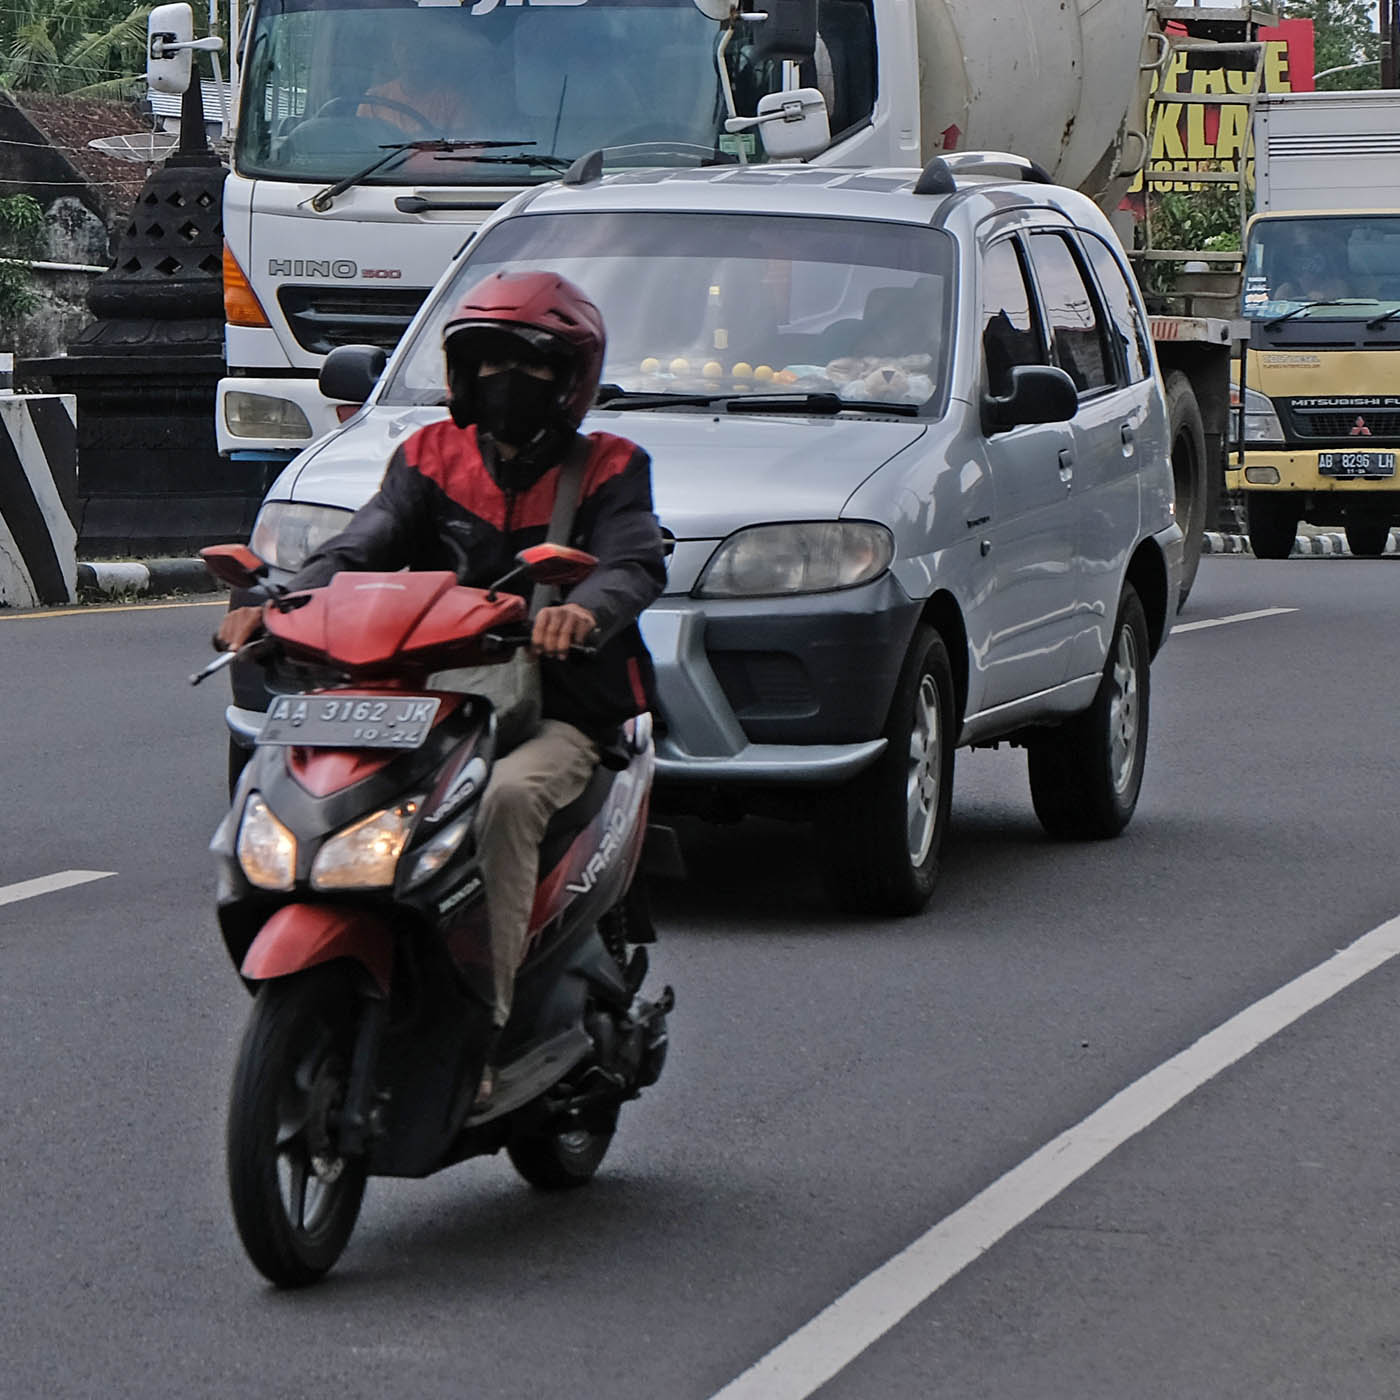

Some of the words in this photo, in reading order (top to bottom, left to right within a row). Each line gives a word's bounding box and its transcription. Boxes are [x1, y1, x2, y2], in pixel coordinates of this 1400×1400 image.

[268, 259, 358, 279] HINO
[362, 269, 402, 279] 500
[1291, 398, 1380, 406] MITSUBISHI
[1319, 454, 1333, 467] AB
[1378, 454, 1394, 468] LH
[273, 701, 308, 720] AA
[320, 701, 389, 722] 3162
[396, 703, 433, 723] JK
[565, 807, 626, 893] VARIO
